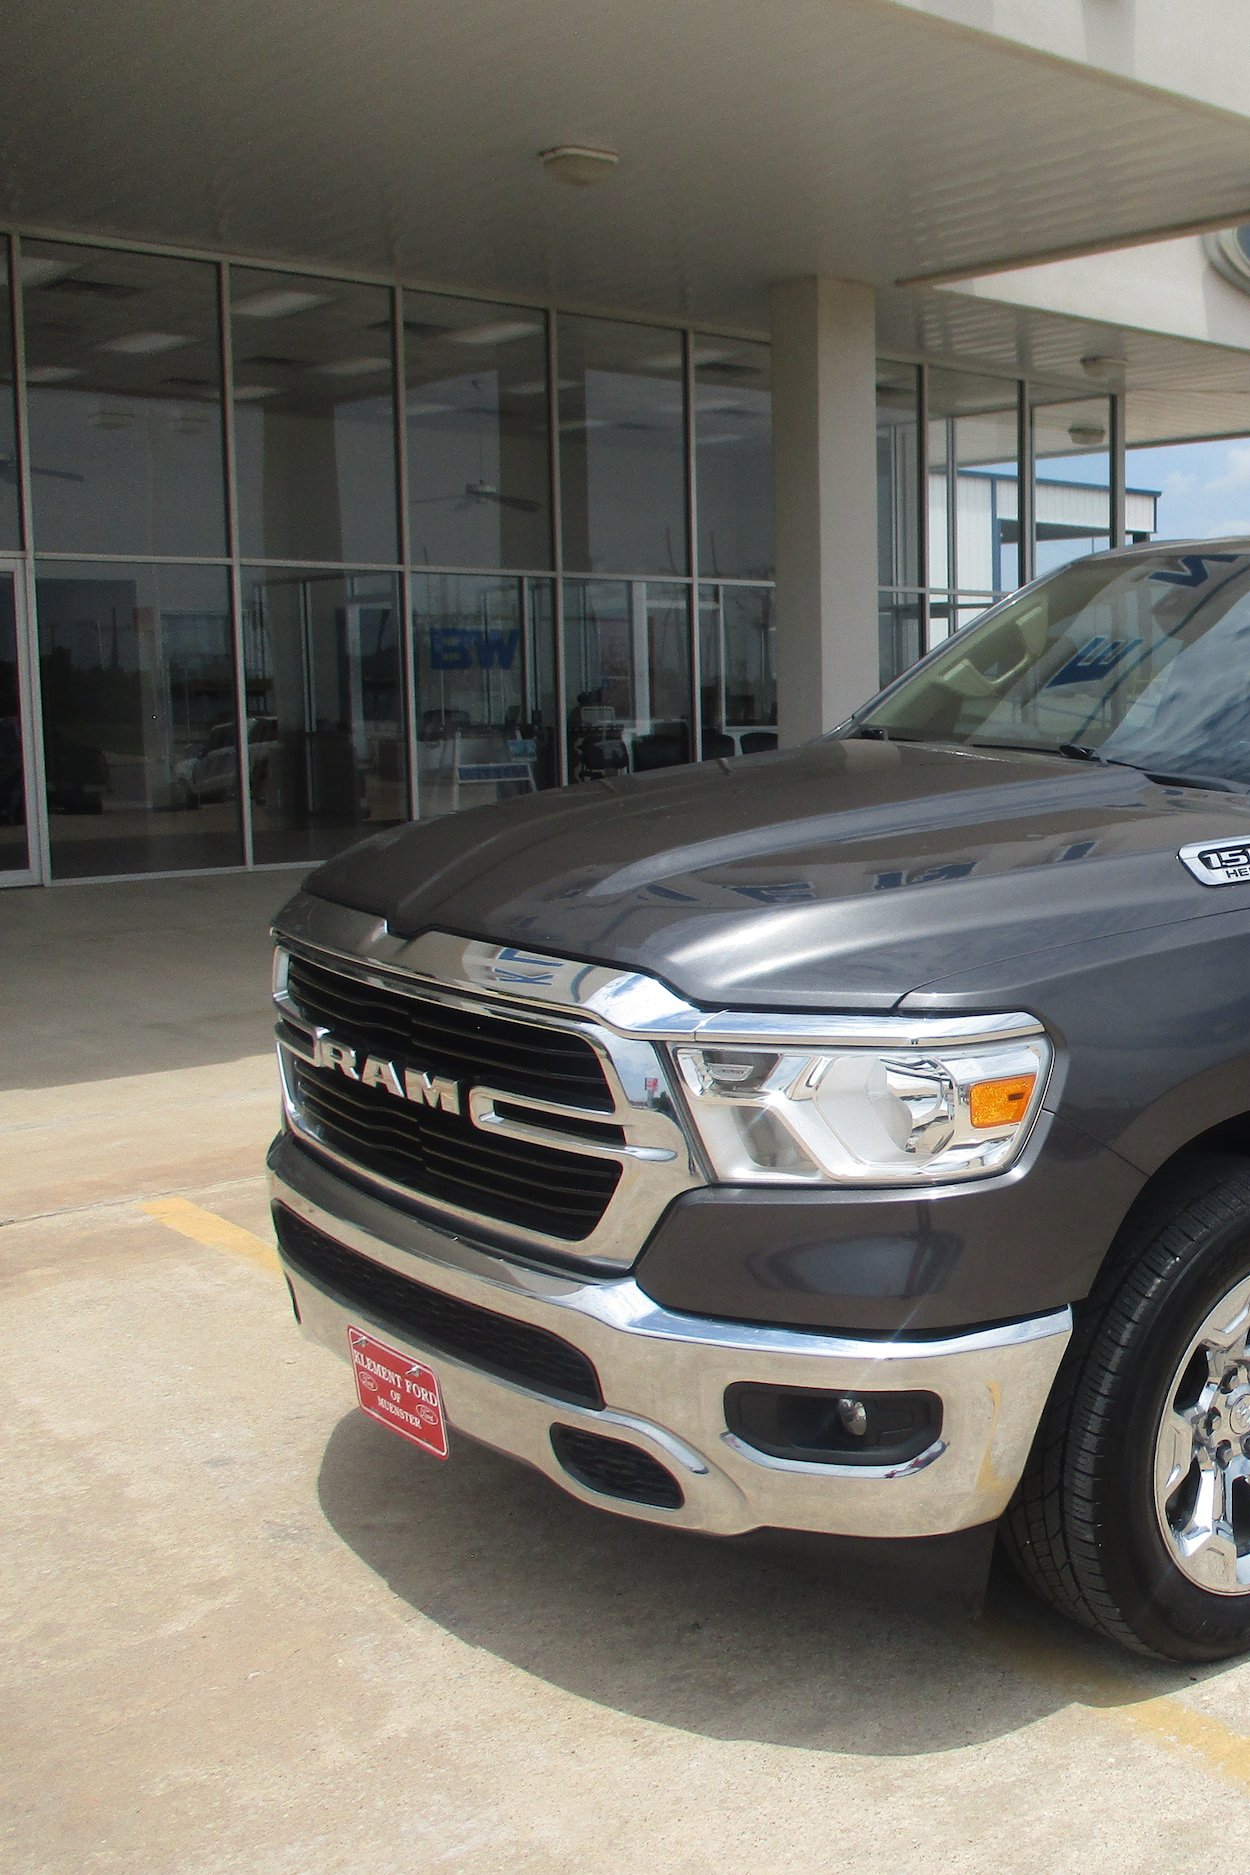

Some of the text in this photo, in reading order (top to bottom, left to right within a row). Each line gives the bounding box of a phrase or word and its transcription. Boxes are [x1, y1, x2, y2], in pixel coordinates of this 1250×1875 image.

[320, 1037, 461, 1115] RAM
[353, 1349, 438, 1406] KLEMENT FORD
[390, 1390, 402, 1402] OF
[377, 1396, 422, 1429] MUENSTER
